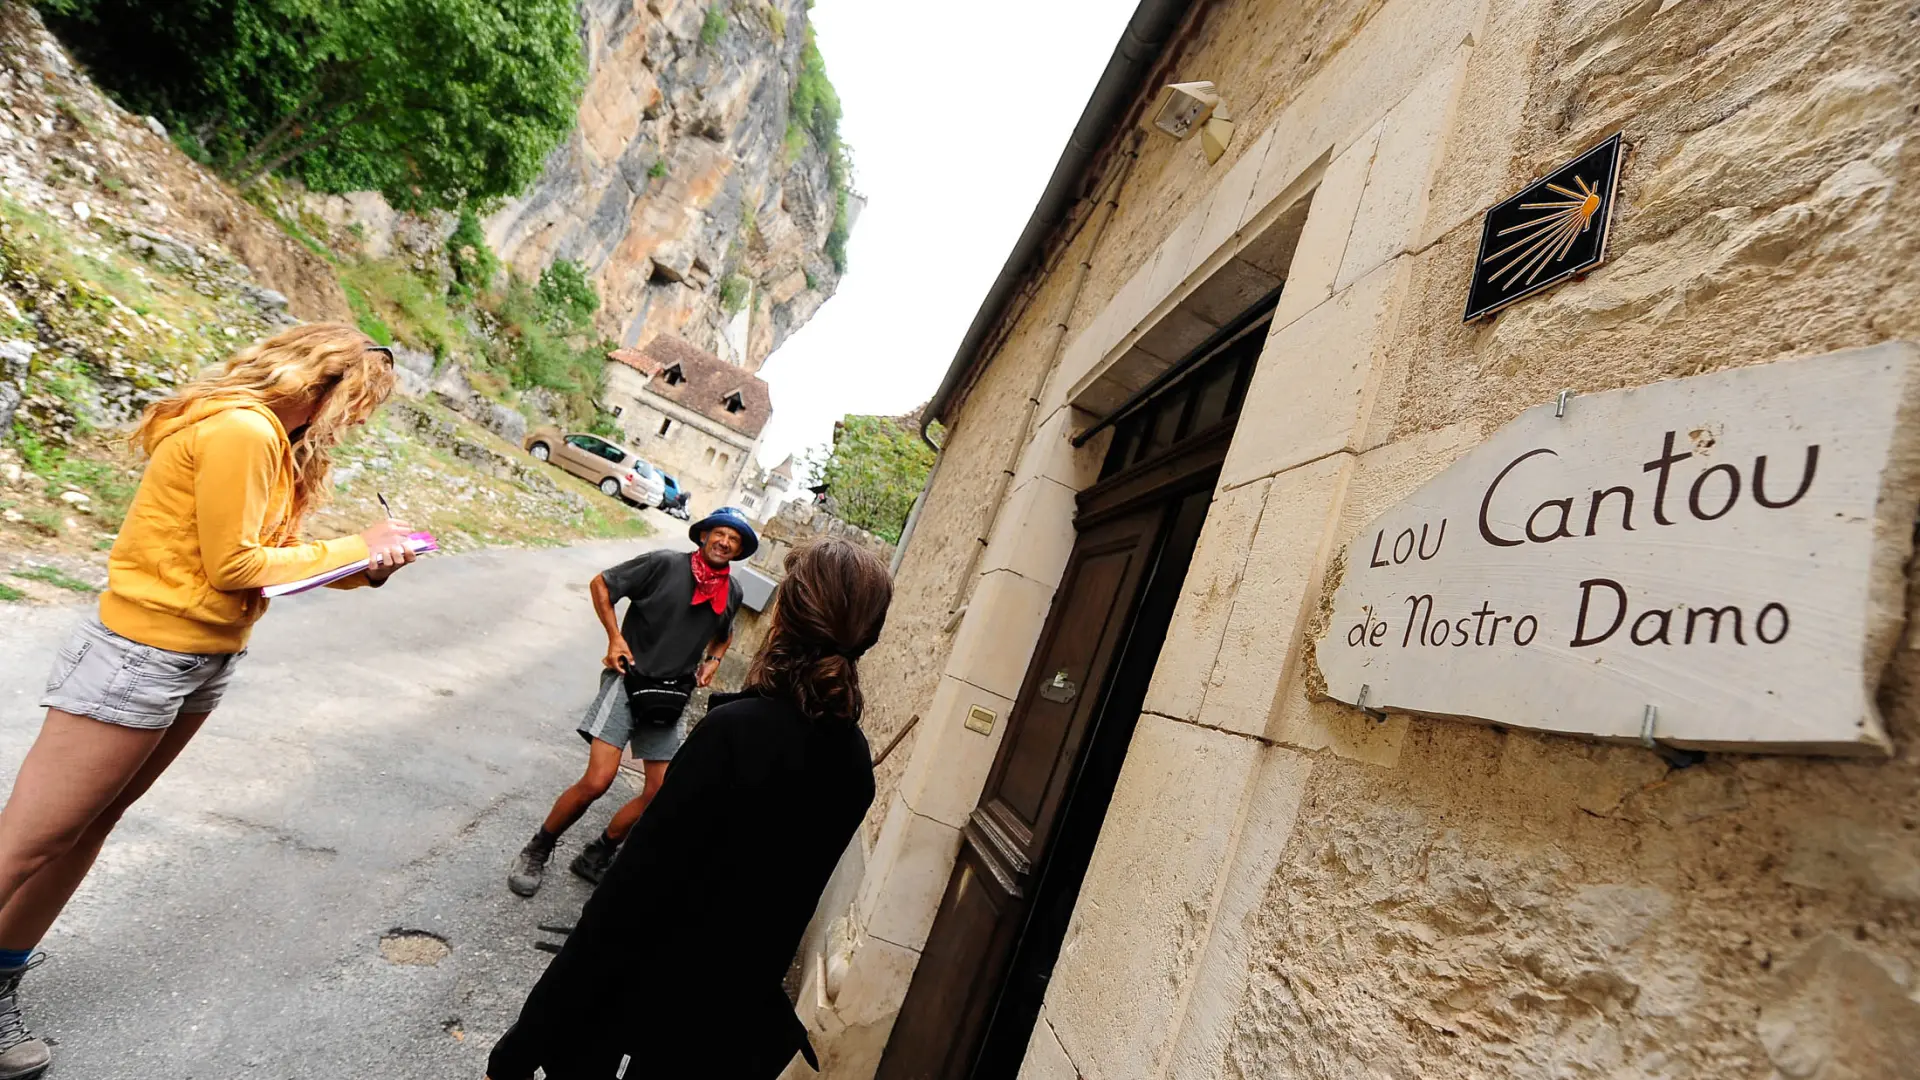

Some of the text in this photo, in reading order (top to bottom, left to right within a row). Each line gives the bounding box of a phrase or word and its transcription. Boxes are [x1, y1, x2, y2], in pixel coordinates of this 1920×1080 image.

[1346, 577, 1791, 649] de Nostro Damo
